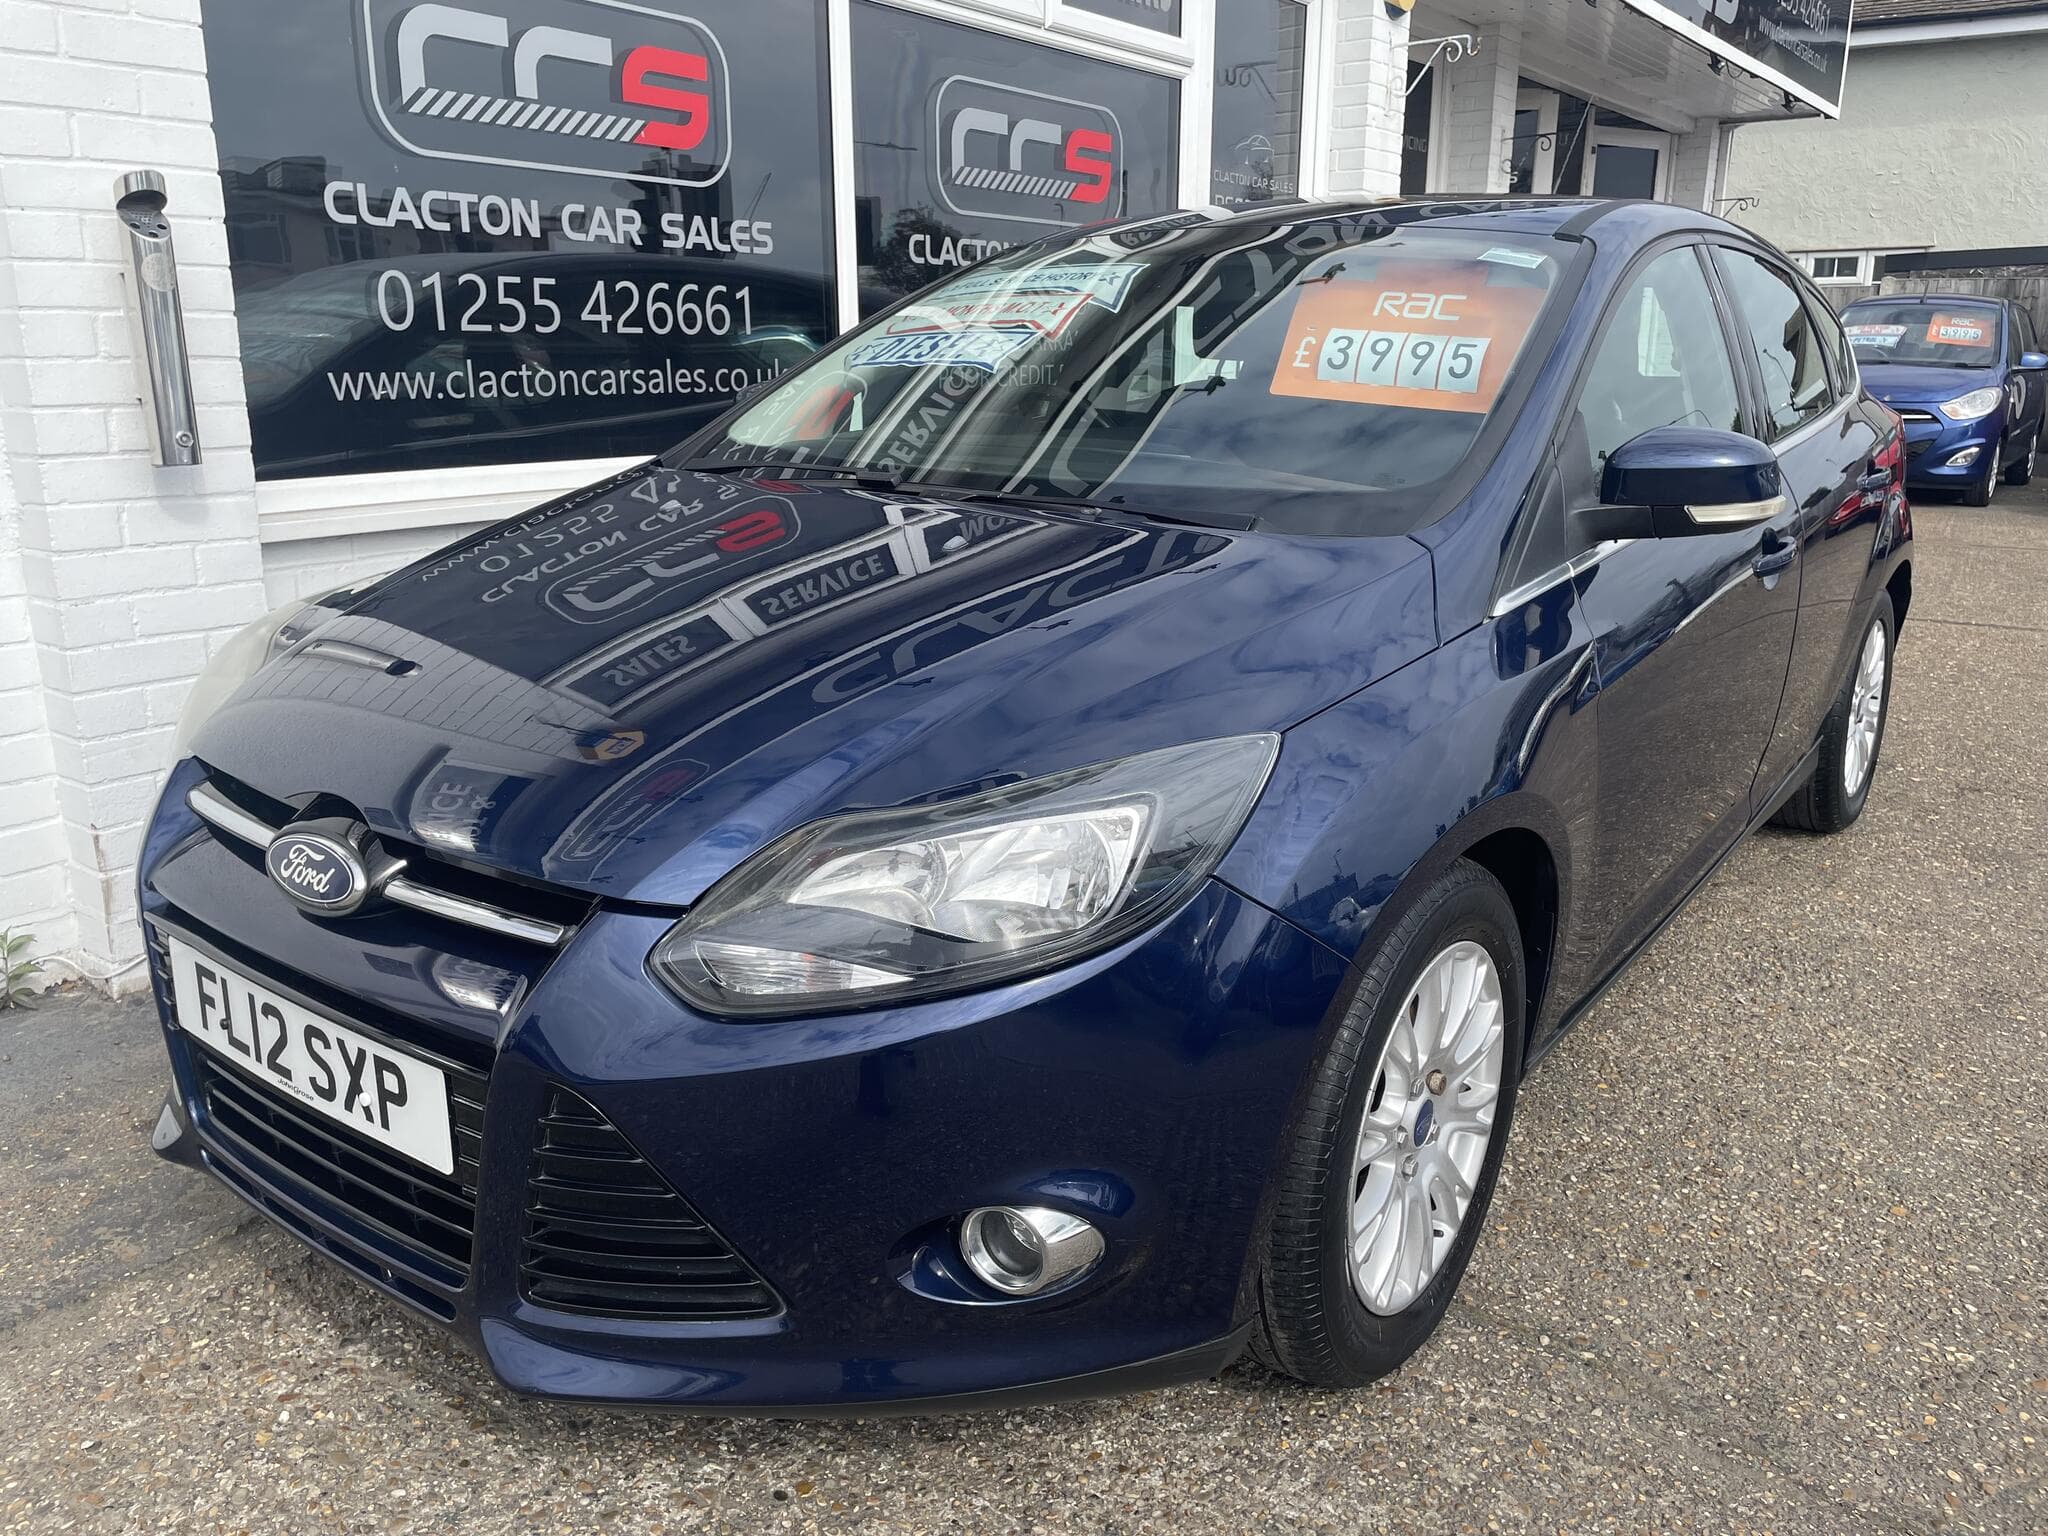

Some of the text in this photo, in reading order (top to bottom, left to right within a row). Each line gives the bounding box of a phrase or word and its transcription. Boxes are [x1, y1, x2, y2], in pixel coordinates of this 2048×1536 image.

[1269, 180, 1294, 194] SALES
[322, 181, 774, 255] CLACTON CAR SALES
[908, 233, 1018, 268] CLACTO
[376, 269, 753, 336] 01255 426661
[327, 358, 788, 402] www.clactoncarsales.couk
[1326, 335, 1478, 379] 3995
[279, 844, 337, 894] Ford
[194, 961, 409, 1132] FL12 SXP
